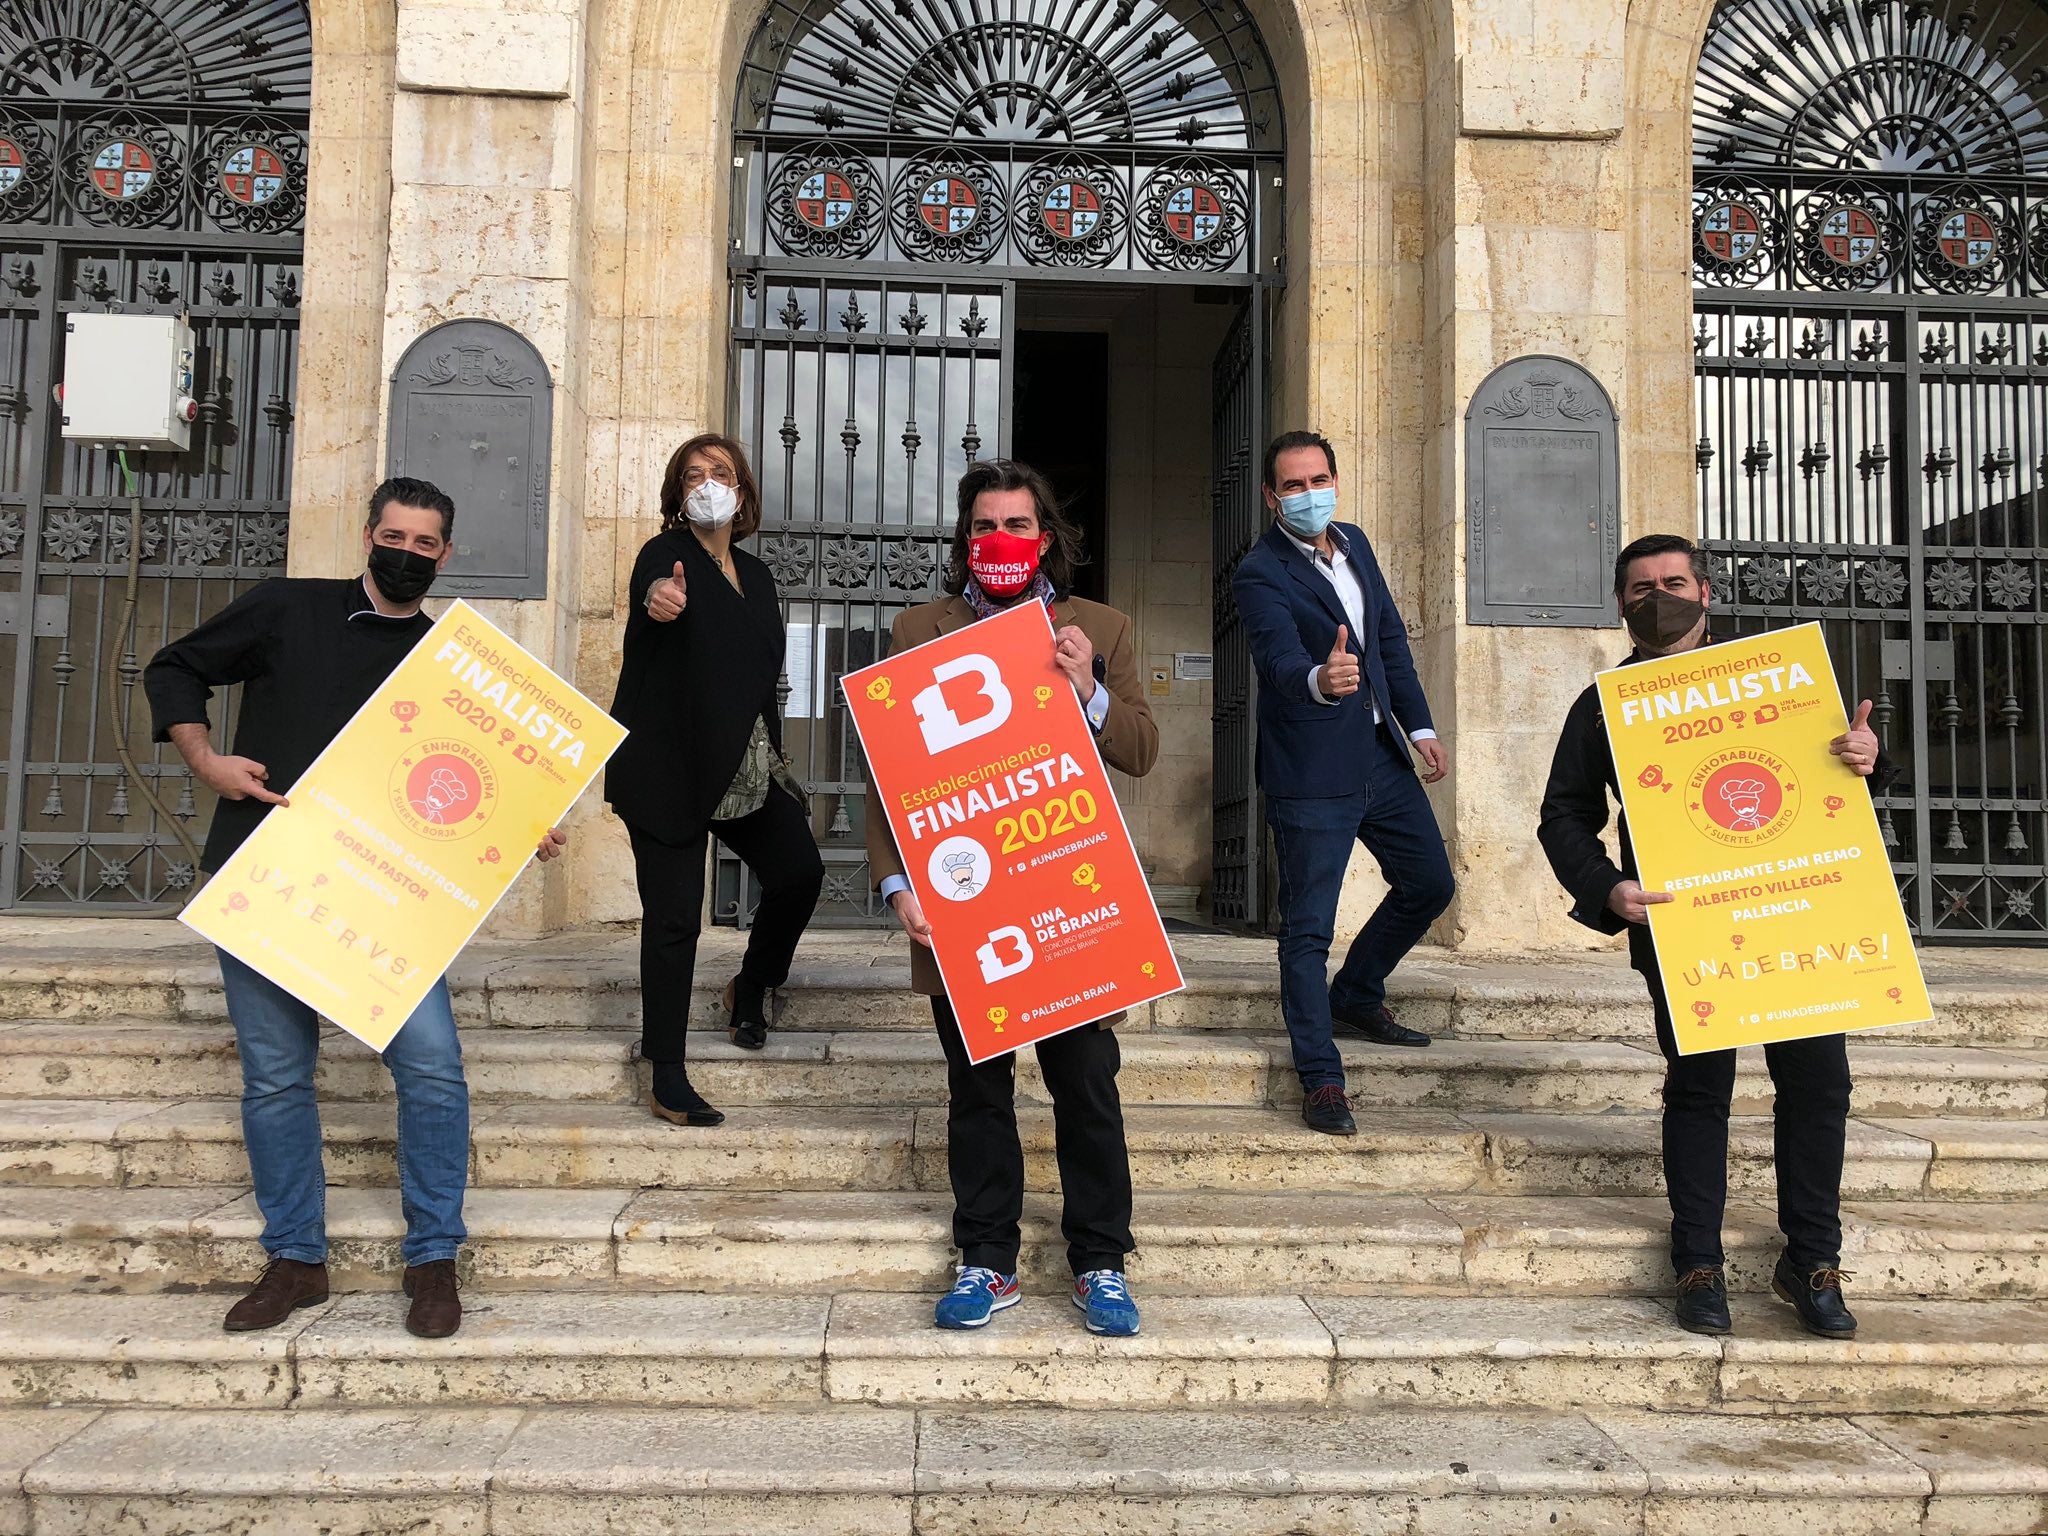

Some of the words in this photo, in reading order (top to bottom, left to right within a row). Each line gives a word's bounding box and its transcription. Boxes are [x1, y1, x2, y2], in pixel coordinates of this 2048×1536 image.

[972, 561, 1030, 574] SALVEMOSLA
[454, 624, 583, 731] Establecimiento
[1617, 652, 1782, 699] Establecimiento
[1621, 662, 1815, 726] FINALISTA
[434, 640, 586, 768] FINALISTA
[442, 688, 498, 734] 2020
[1780, 698, 1796, 706] UNA
[1792, 698, 1821, 709] BRAVAS
[1662, 715, 1724, 745] 2020
[422, 742, 494, 800] ENHORABUENA
[900, 743, 1052, 811] Establecimiento
[1691, 750, 1783, 789] ENHORABUENA
[907, 752, 1085, 840] FINALISTA
[422, 826, 457, 838] BORJA
[995, 788, 1097, 855] 2020
[1704, 823, 1711, 832] Y
[1711, 829, 1753, 844] SUERTE,
[1756, 809, 1793, 842] ALBERTO
[334, 829, 378, 866] BORJA
[377, 860, 430, 901] PASTOR
[1030, 831, 1109, 868] #UNADEBRAVAS
[1664, 862, 1775, 892] RESTAURANTE
[1777, 855, 1810, 872] SAN
[1812, 846, 1862, 865] REMO
[403, 852, 480, 912] GASTROBAR
[1692, 885, 1763, 908] ALBERTO
[1765, 871, 1843, 895] VILLEGAS
[1030, 906, 1067, 928] UNA
[1035, 925, 1059, 944] DE
[1059, 902, 1120, 935] BRAVAS
[1732, 898, 1812, 923] PALENCIA
[1044, 934, 1078, 952] CONCURSO
[1078, 918, 1124, 940] INTERNACIONAL
[1044, 953, 1054, 963] DE
[1053, 944, 1078, 959] PATATAS
[1077, 937, 1099, 950] BRAVAS
[1682, 957, 1736, 987] UNA
[1741, 954, 1775, 980] DE
[1779, 933, 1889, 972] BRAVAS!
[1031, 993, 1083, 1019] PALENCIA
[1082, 981, 1118, 1001] BRAVA
[1765, 999, 1861, 1022] #UNADEBRAVAS
